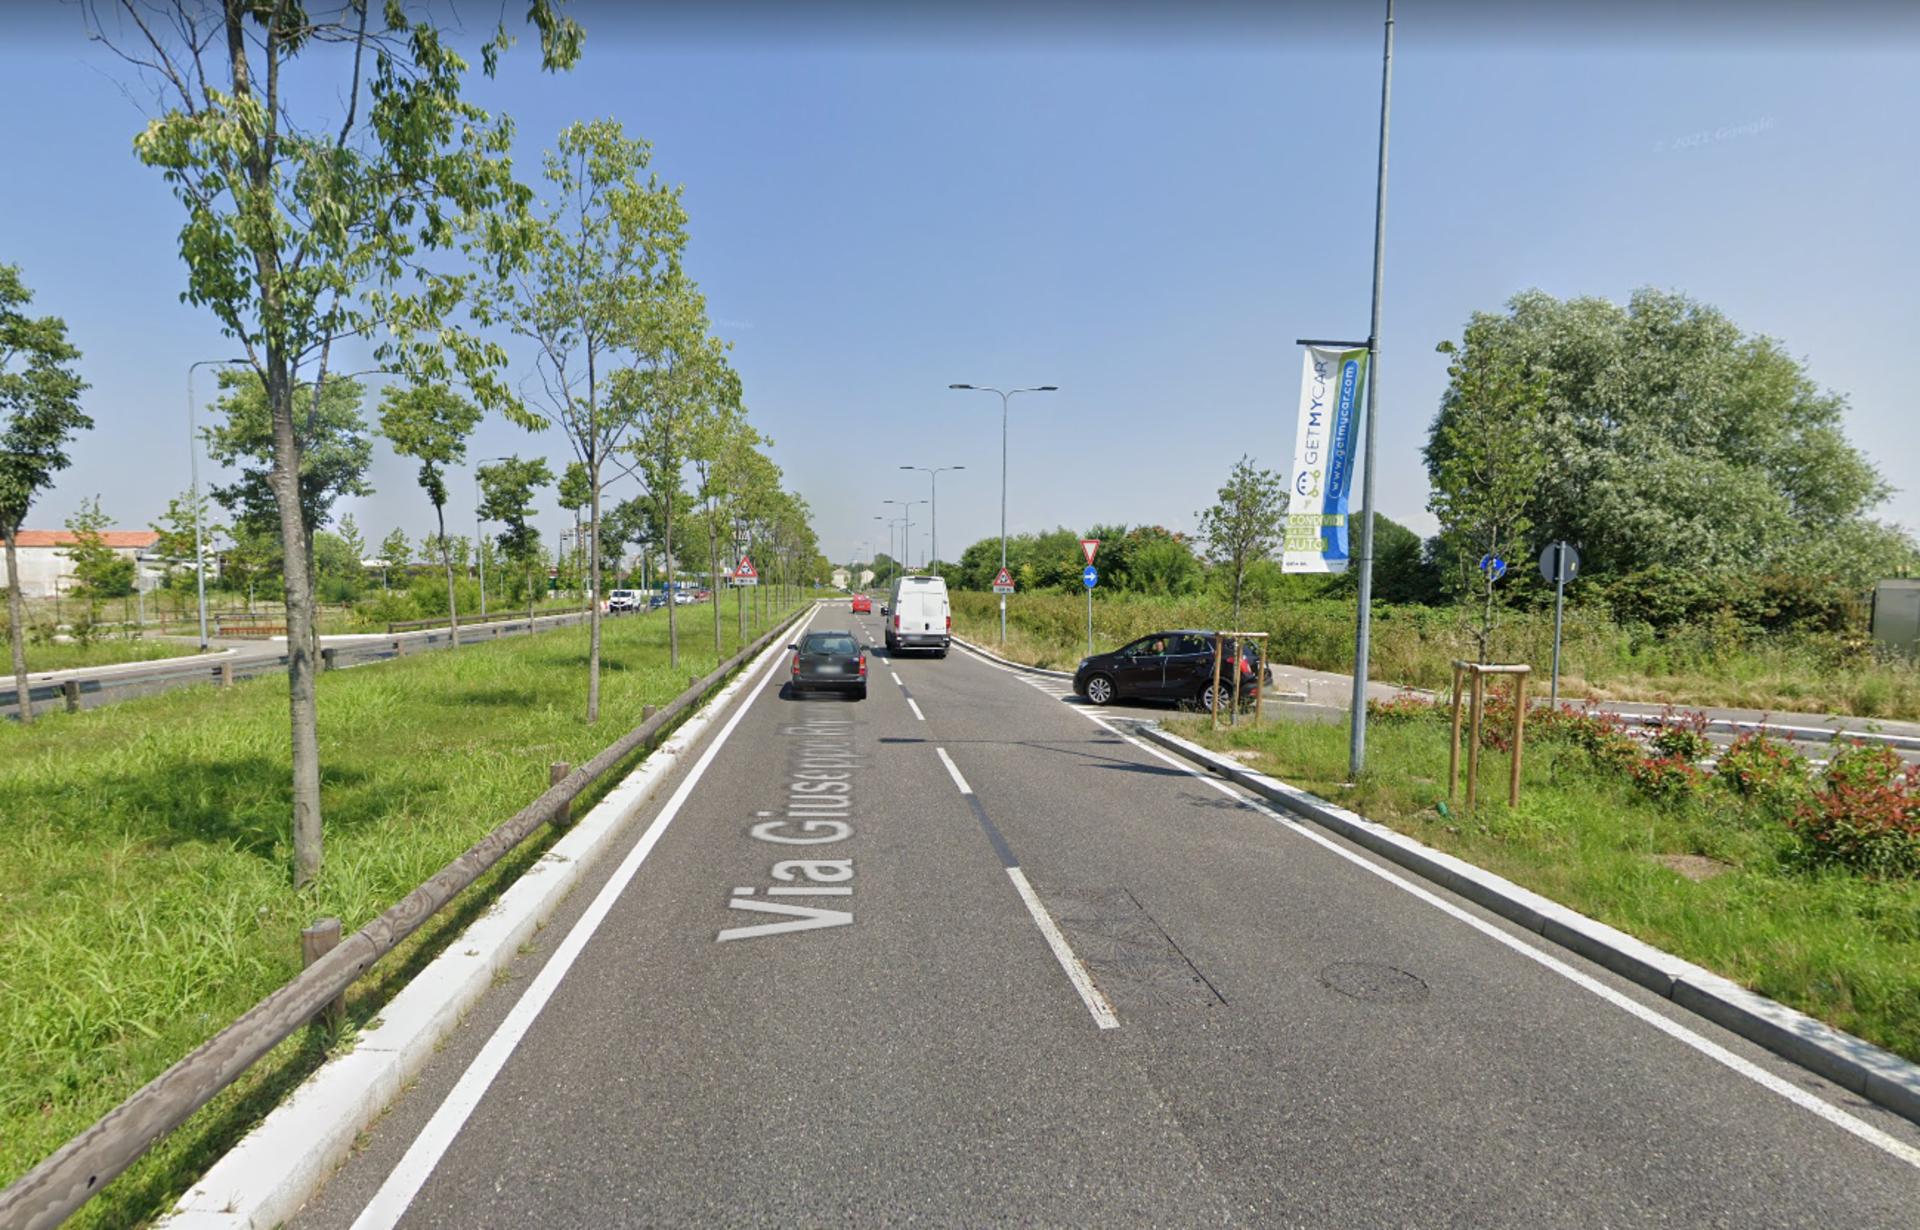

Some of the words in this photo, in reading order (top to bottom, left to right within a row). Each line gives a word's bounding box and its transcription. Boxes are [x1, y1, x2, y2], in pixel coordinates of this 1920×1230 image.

[1304, 360, 1329, 466] GETMYCAR
[1332, 366, 1355, 492] www.getmycar.com
[1287, 538, 1325, 552] AUTO
